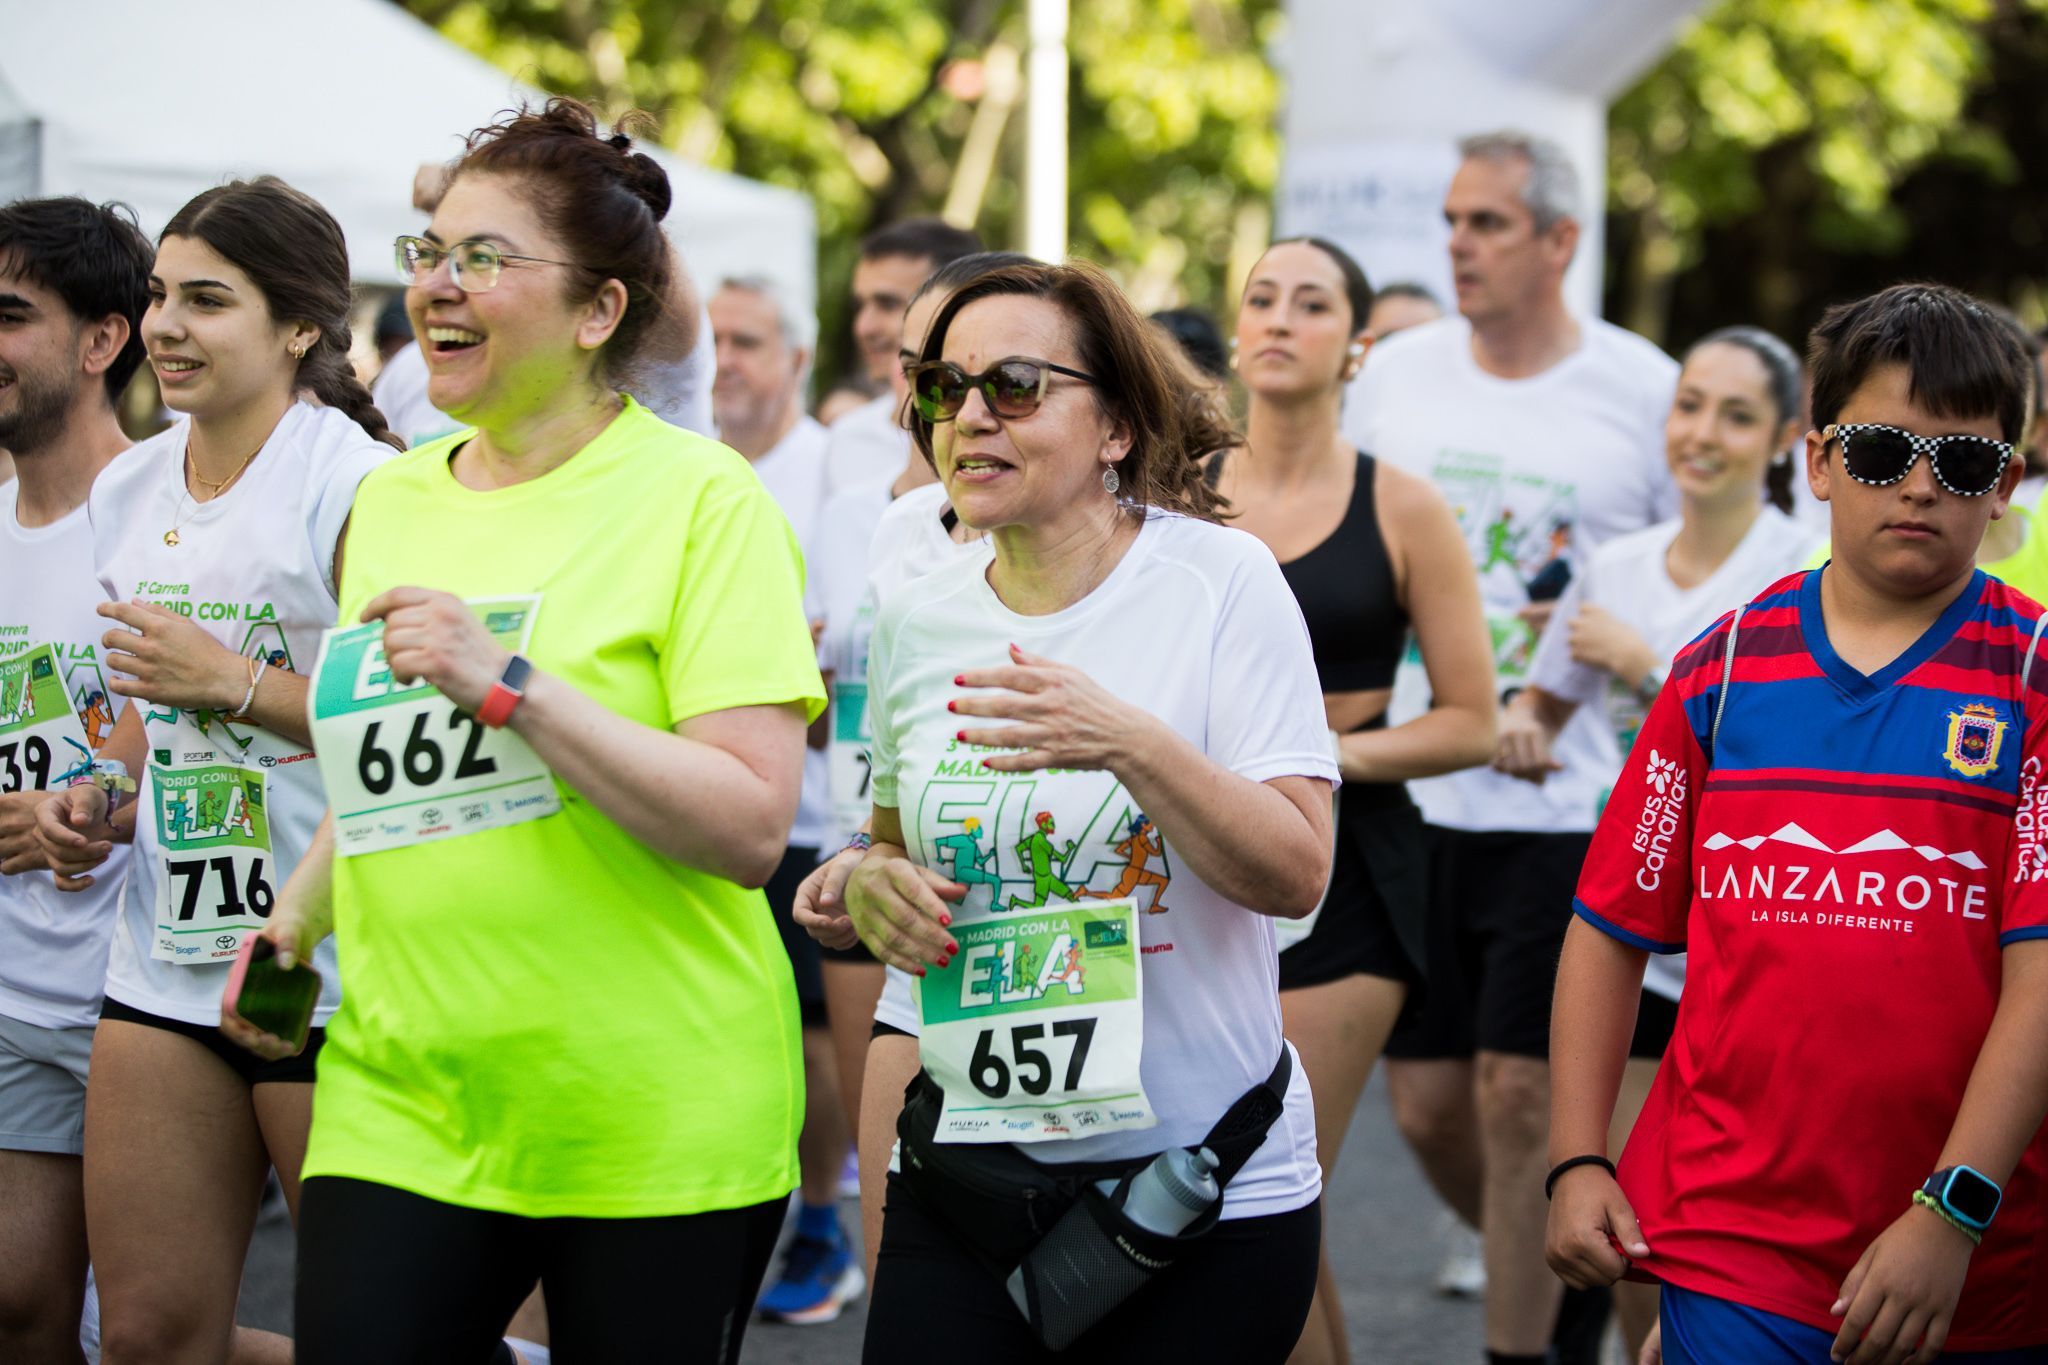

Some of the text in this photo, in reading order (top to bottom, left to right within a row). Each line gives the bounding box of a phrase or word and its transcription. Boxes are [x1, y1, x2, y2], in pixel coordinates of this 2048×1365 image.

[149, 582, 190, 595] Carrera
[198, 602, 238, 621] CON
[244, 603, 276, 620] LA
[69, 643, 96, 660] LA
[201, 772, 228, 784] CON
[358, 707, 499, 796] 662
[934, 759, 1034, 777] MAD
[163, 786, 255, 841] ELA
[1632, 795, 1663, 854] Islas
[1636, 767, 1687, 892] Canarias
[168, 856, 274, 921] 716
[1700, 863, 1987, 920] LANZAROTE
[966, 926, 1016, 945] MADRID
[1018, 920, 1050, 936] CON
[1052, 918, 1071, 932] LA
[1751, 910, 1914, 933] LA ISLA DIFERENTE
[960, 933, 1085, 1010] ELA
[969, 1017, 1099, 1099] 657
